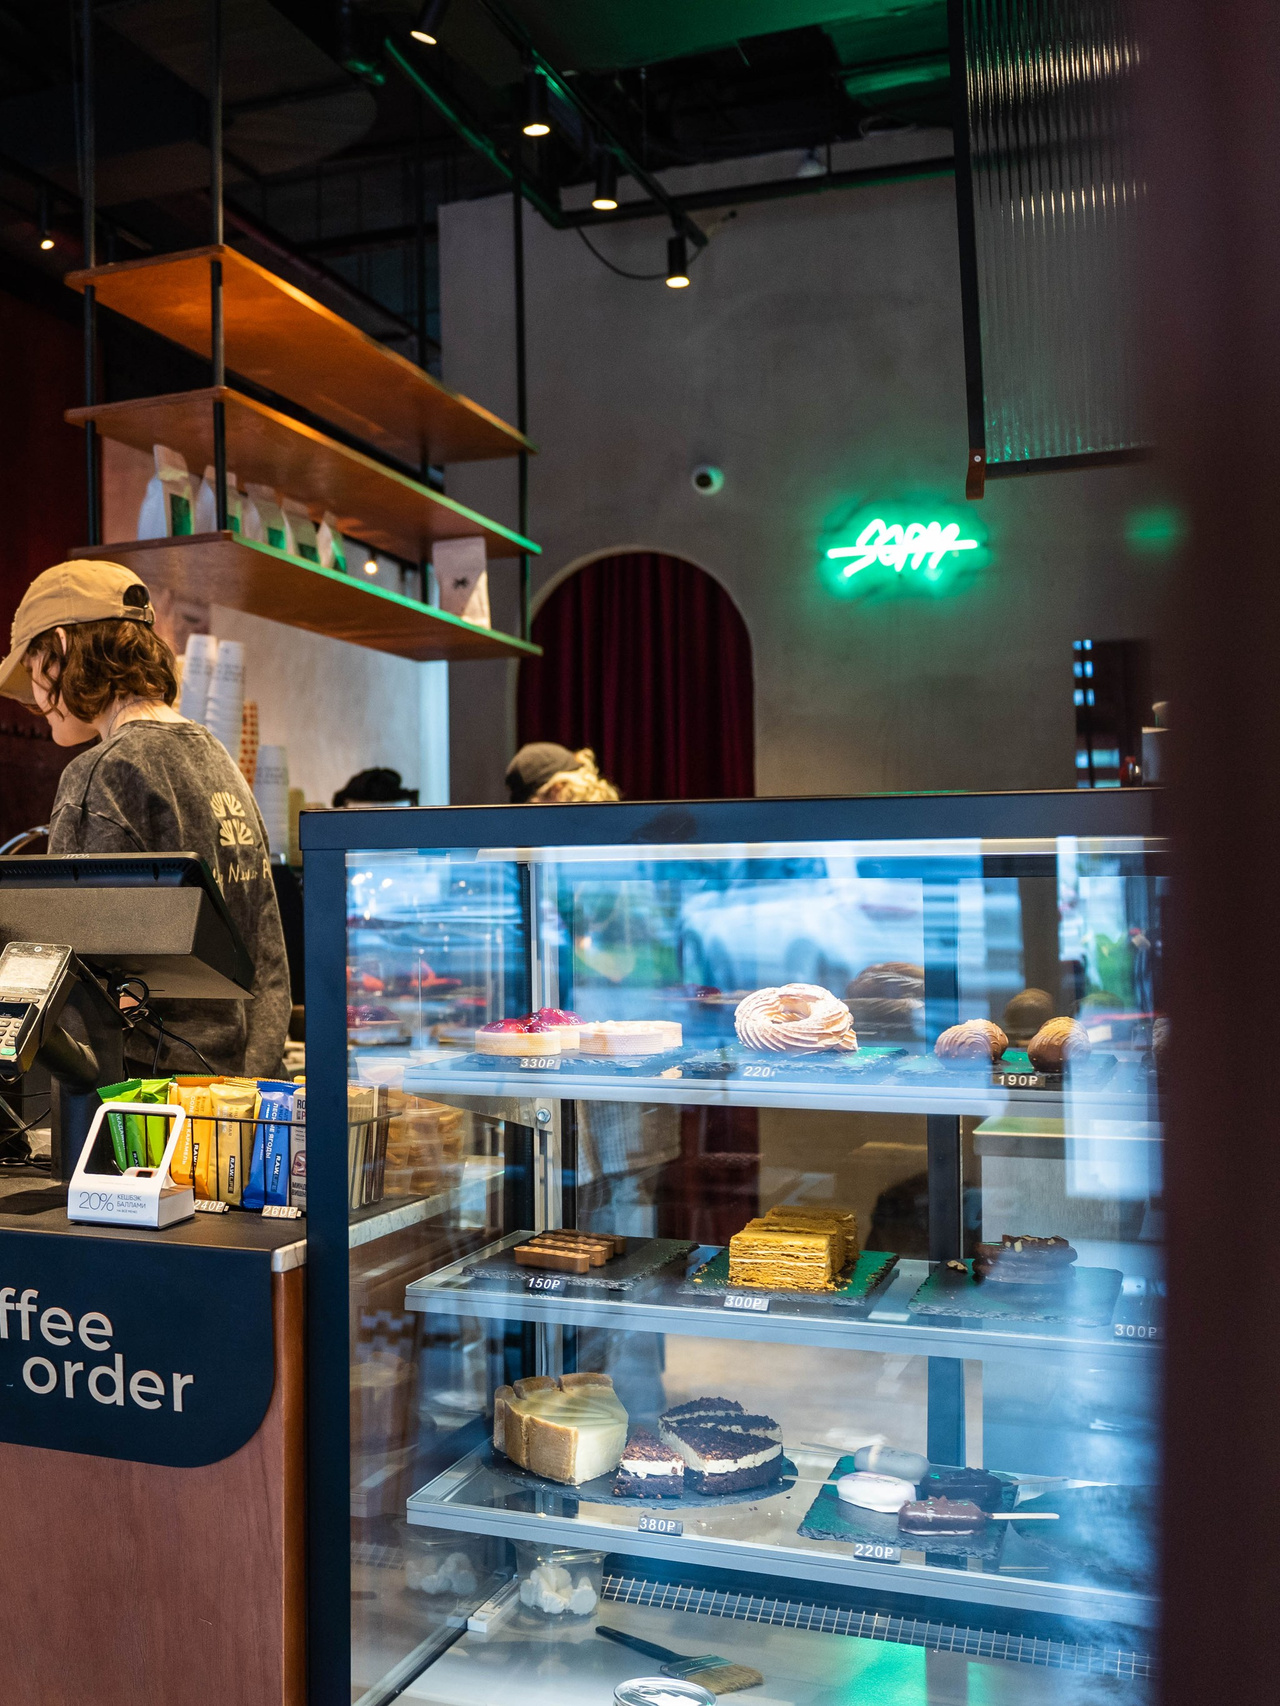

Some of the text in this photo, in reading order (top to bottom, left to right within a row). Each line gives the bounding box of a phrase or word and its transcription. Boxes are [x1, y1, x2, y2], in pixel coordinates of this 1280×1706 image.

[182, 1129, 191, 1165] КАРАМЕЛЬ
[265, 1133, 275, 1159] ЯГОДЫ
[79, 1191, 115, 1212] 20%
[117, 1201, 146, 1209] БАЛЛАМИ
[22, 1353, 194, 1412] order
